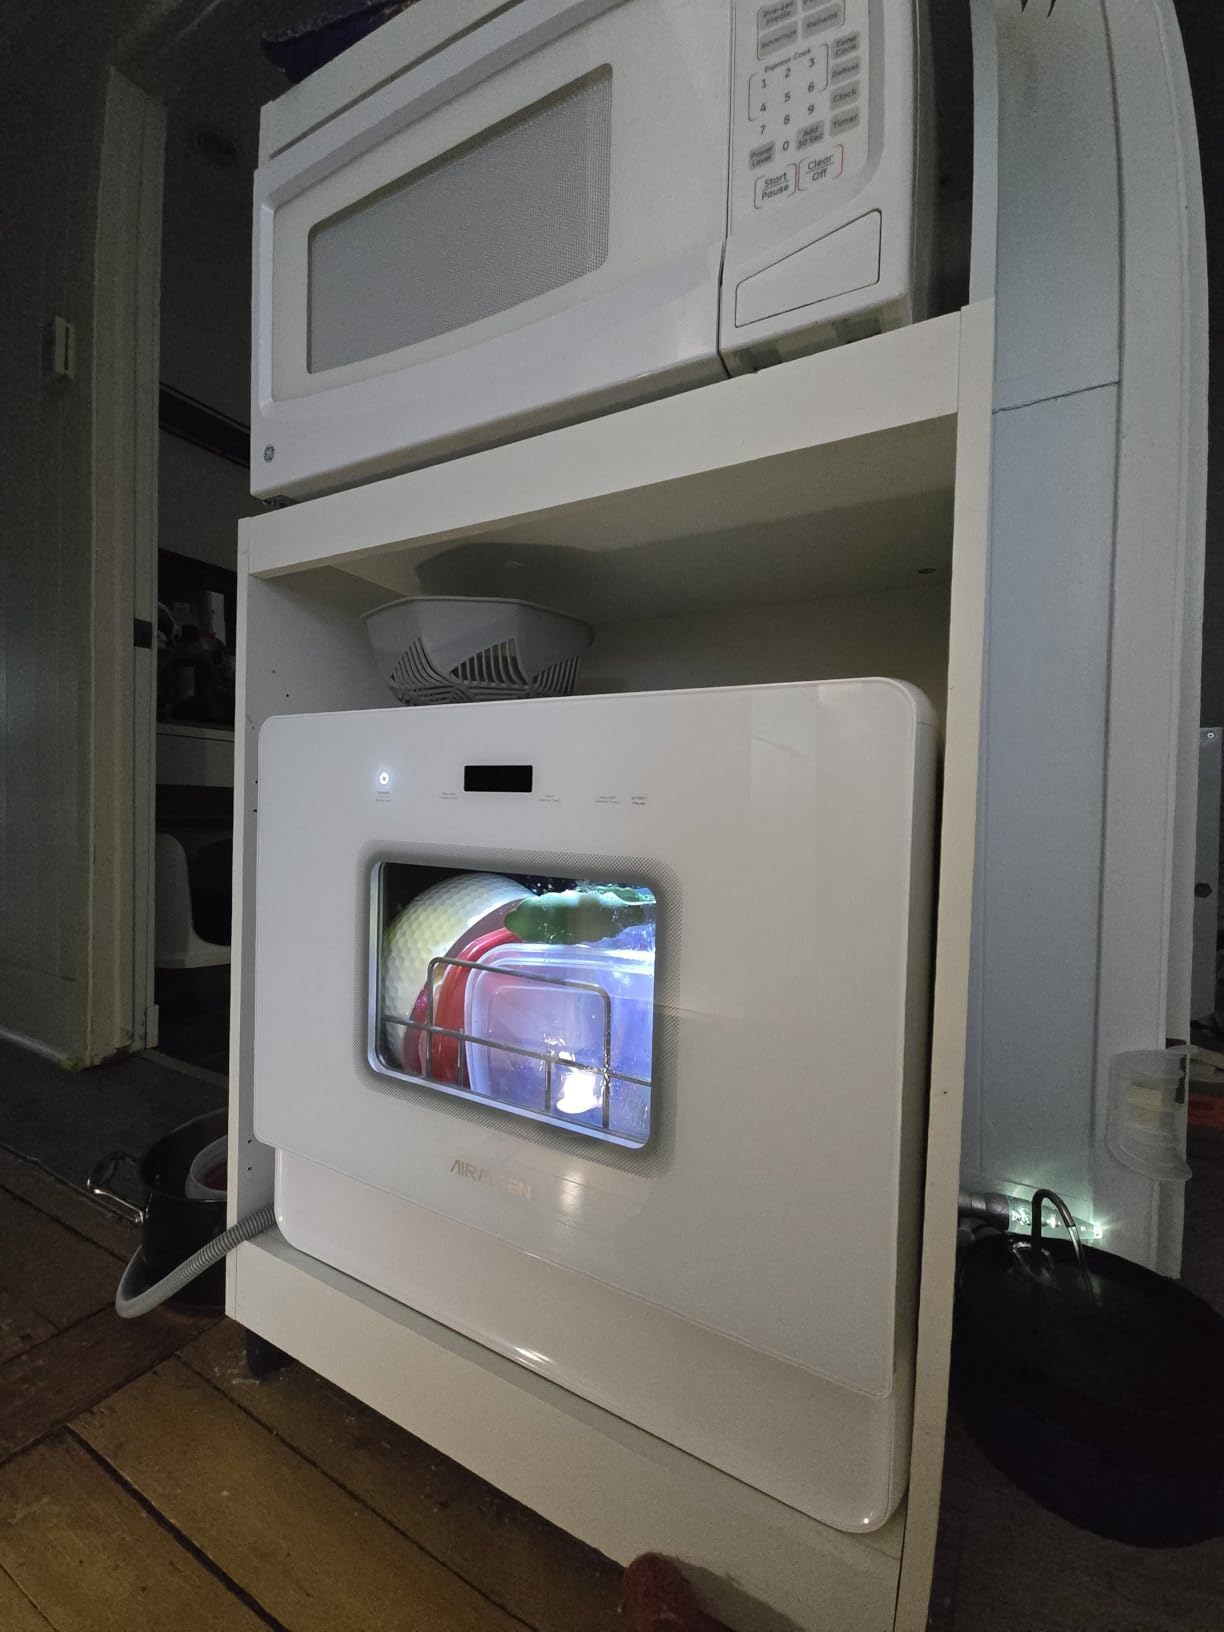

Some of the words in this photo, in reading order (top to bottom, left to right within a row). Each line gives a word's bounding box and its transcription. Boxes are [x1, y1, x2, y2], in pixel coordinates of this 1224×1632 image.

[764, 57, 792, 73] Express
[792, 48, 811, 61] Cook
[808, 57, 815, 68] 3
[785, 67, 791, 78] 2
[761, 78, 767, 89] 1
[808, 81, 815, 93] 6
[784, 91, 791, 103] 5
[833, 88, 857, 103] Clock
[760, 103, 767, 113] 4
[808, 104, 815, 116] 9
[784, 114, 790, 126] 8
[832, 114, 858, 129] Timer
[760, 124, 766, 136] 7
[802, 125, 819, 139] Add
[782, 140, 790, 152] 0
[752, 153, 772, 168] Level
[807, 154, 834, 171] Clear
[764, 172, 788, 188] Start
[812, 168, 829, 181] Off
[762, 184, 789, 201] Pause
